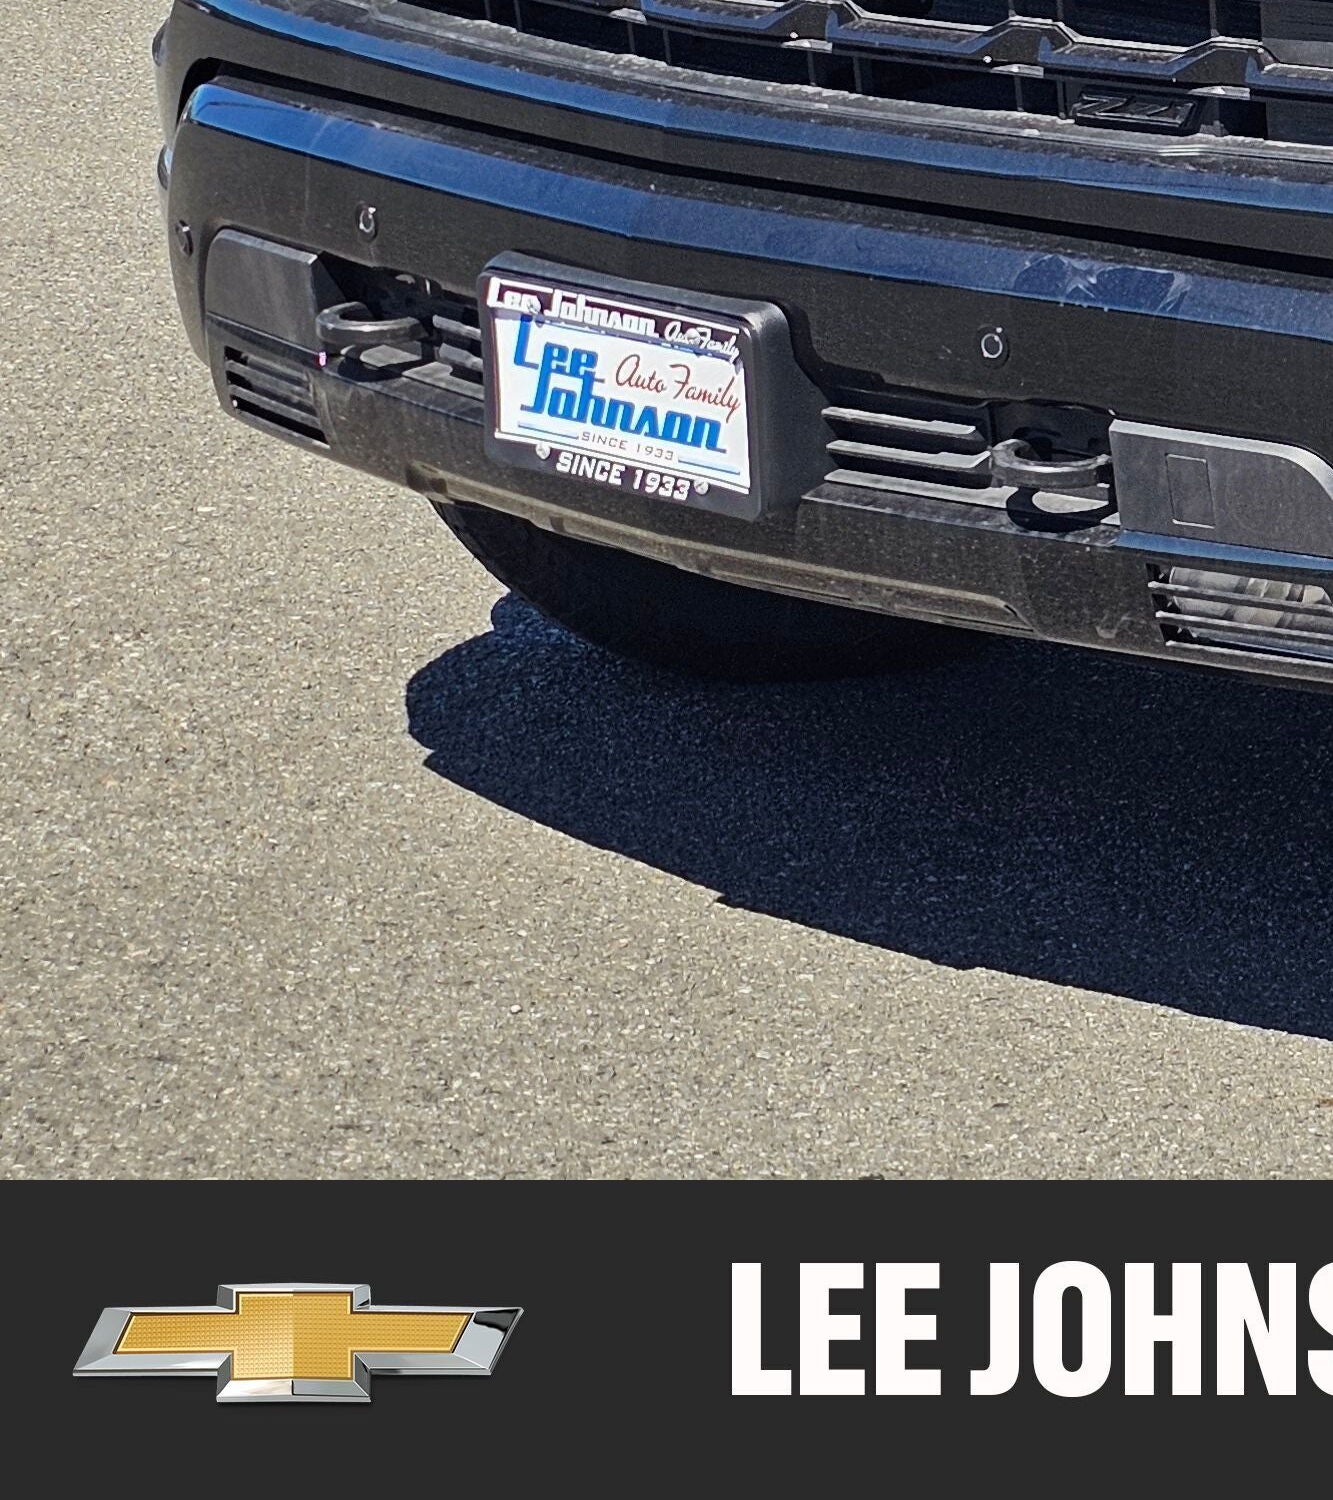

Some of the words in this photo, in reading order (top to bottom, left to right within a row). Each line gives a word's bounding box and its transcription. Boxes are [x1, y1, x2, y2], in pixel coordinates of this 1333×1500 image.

[544, 289, 660, 339] Johnson
[664, 321, 699, 346] Au
[513, 315, 605, 384] Lee
[615, 353, 667, 394] Auto
[668, 363, 741, 424] Family
[520, 364, 727, 454] Johnson
[581, 430, 628, 451] SINCE
[635, 442, 675, 461] 1933
[555, 453, 626, 485] SINCE
[631, 464, 692, 500] 1933
